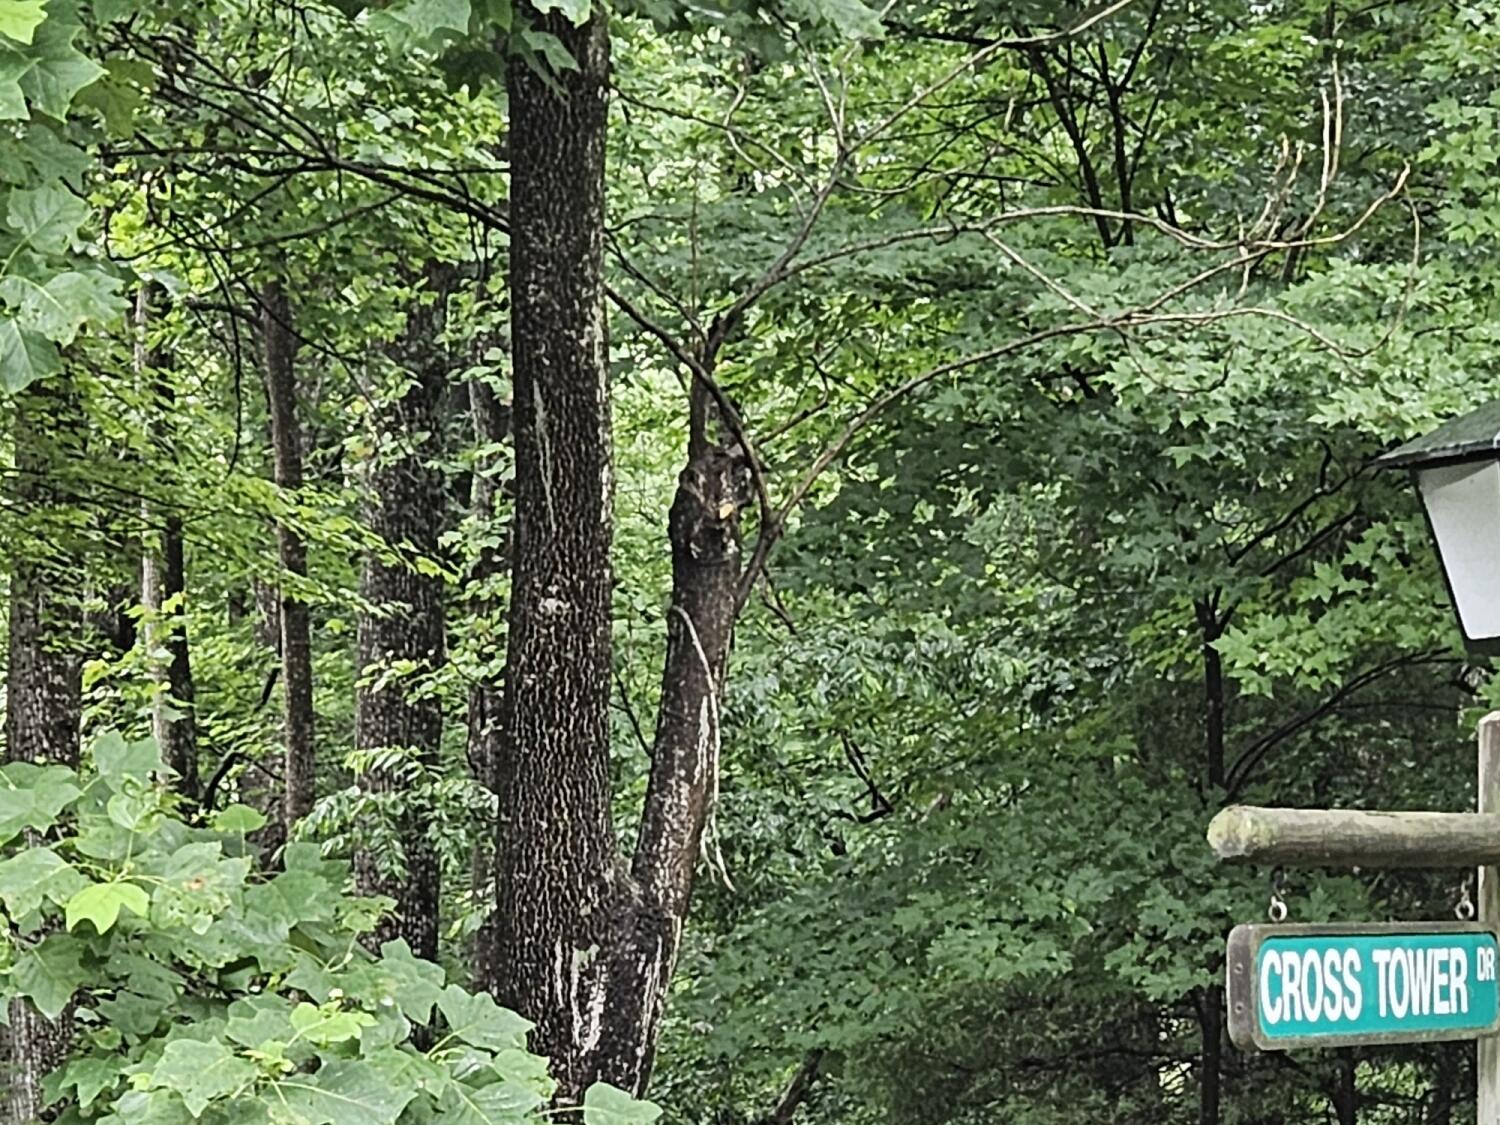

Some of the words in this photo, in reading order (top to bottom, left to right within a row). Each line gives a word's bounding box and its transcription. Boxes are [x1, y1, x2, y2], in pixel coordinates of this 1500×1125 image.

[1260, 948, 1362, 1024] CROSS
[1372, 947, 1468, 1019] TOWER
[1477, 946, 1496, 981] DR
